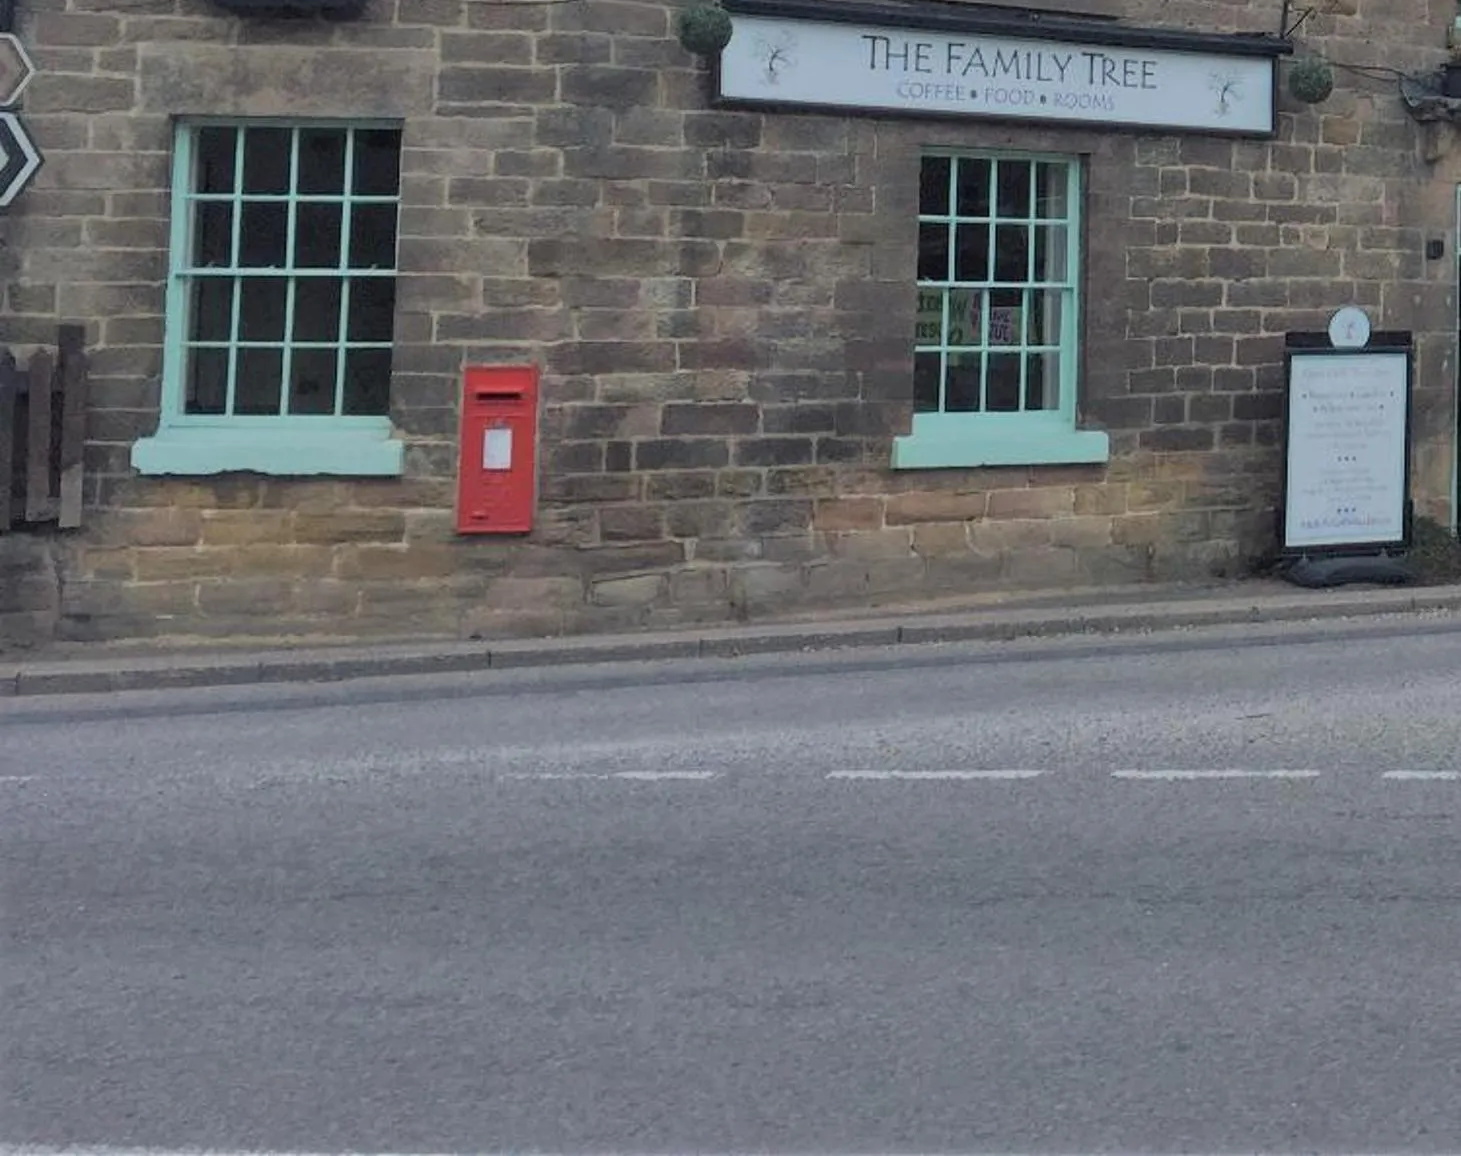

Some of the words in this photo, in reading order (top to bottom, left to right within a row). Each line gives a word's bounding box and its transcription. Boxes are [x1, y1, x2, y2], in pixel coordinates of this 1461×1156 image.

[862, 35, 932, 73] THE
[946, 43, 1072, 82] FAMILY
[1081, 51, 1158, 90] TREE
[897, 81, 966, 102] COFFEE
[984, 87, 1035, 106] FOOD
[1054, 92, 1115, 112] ROOMS
